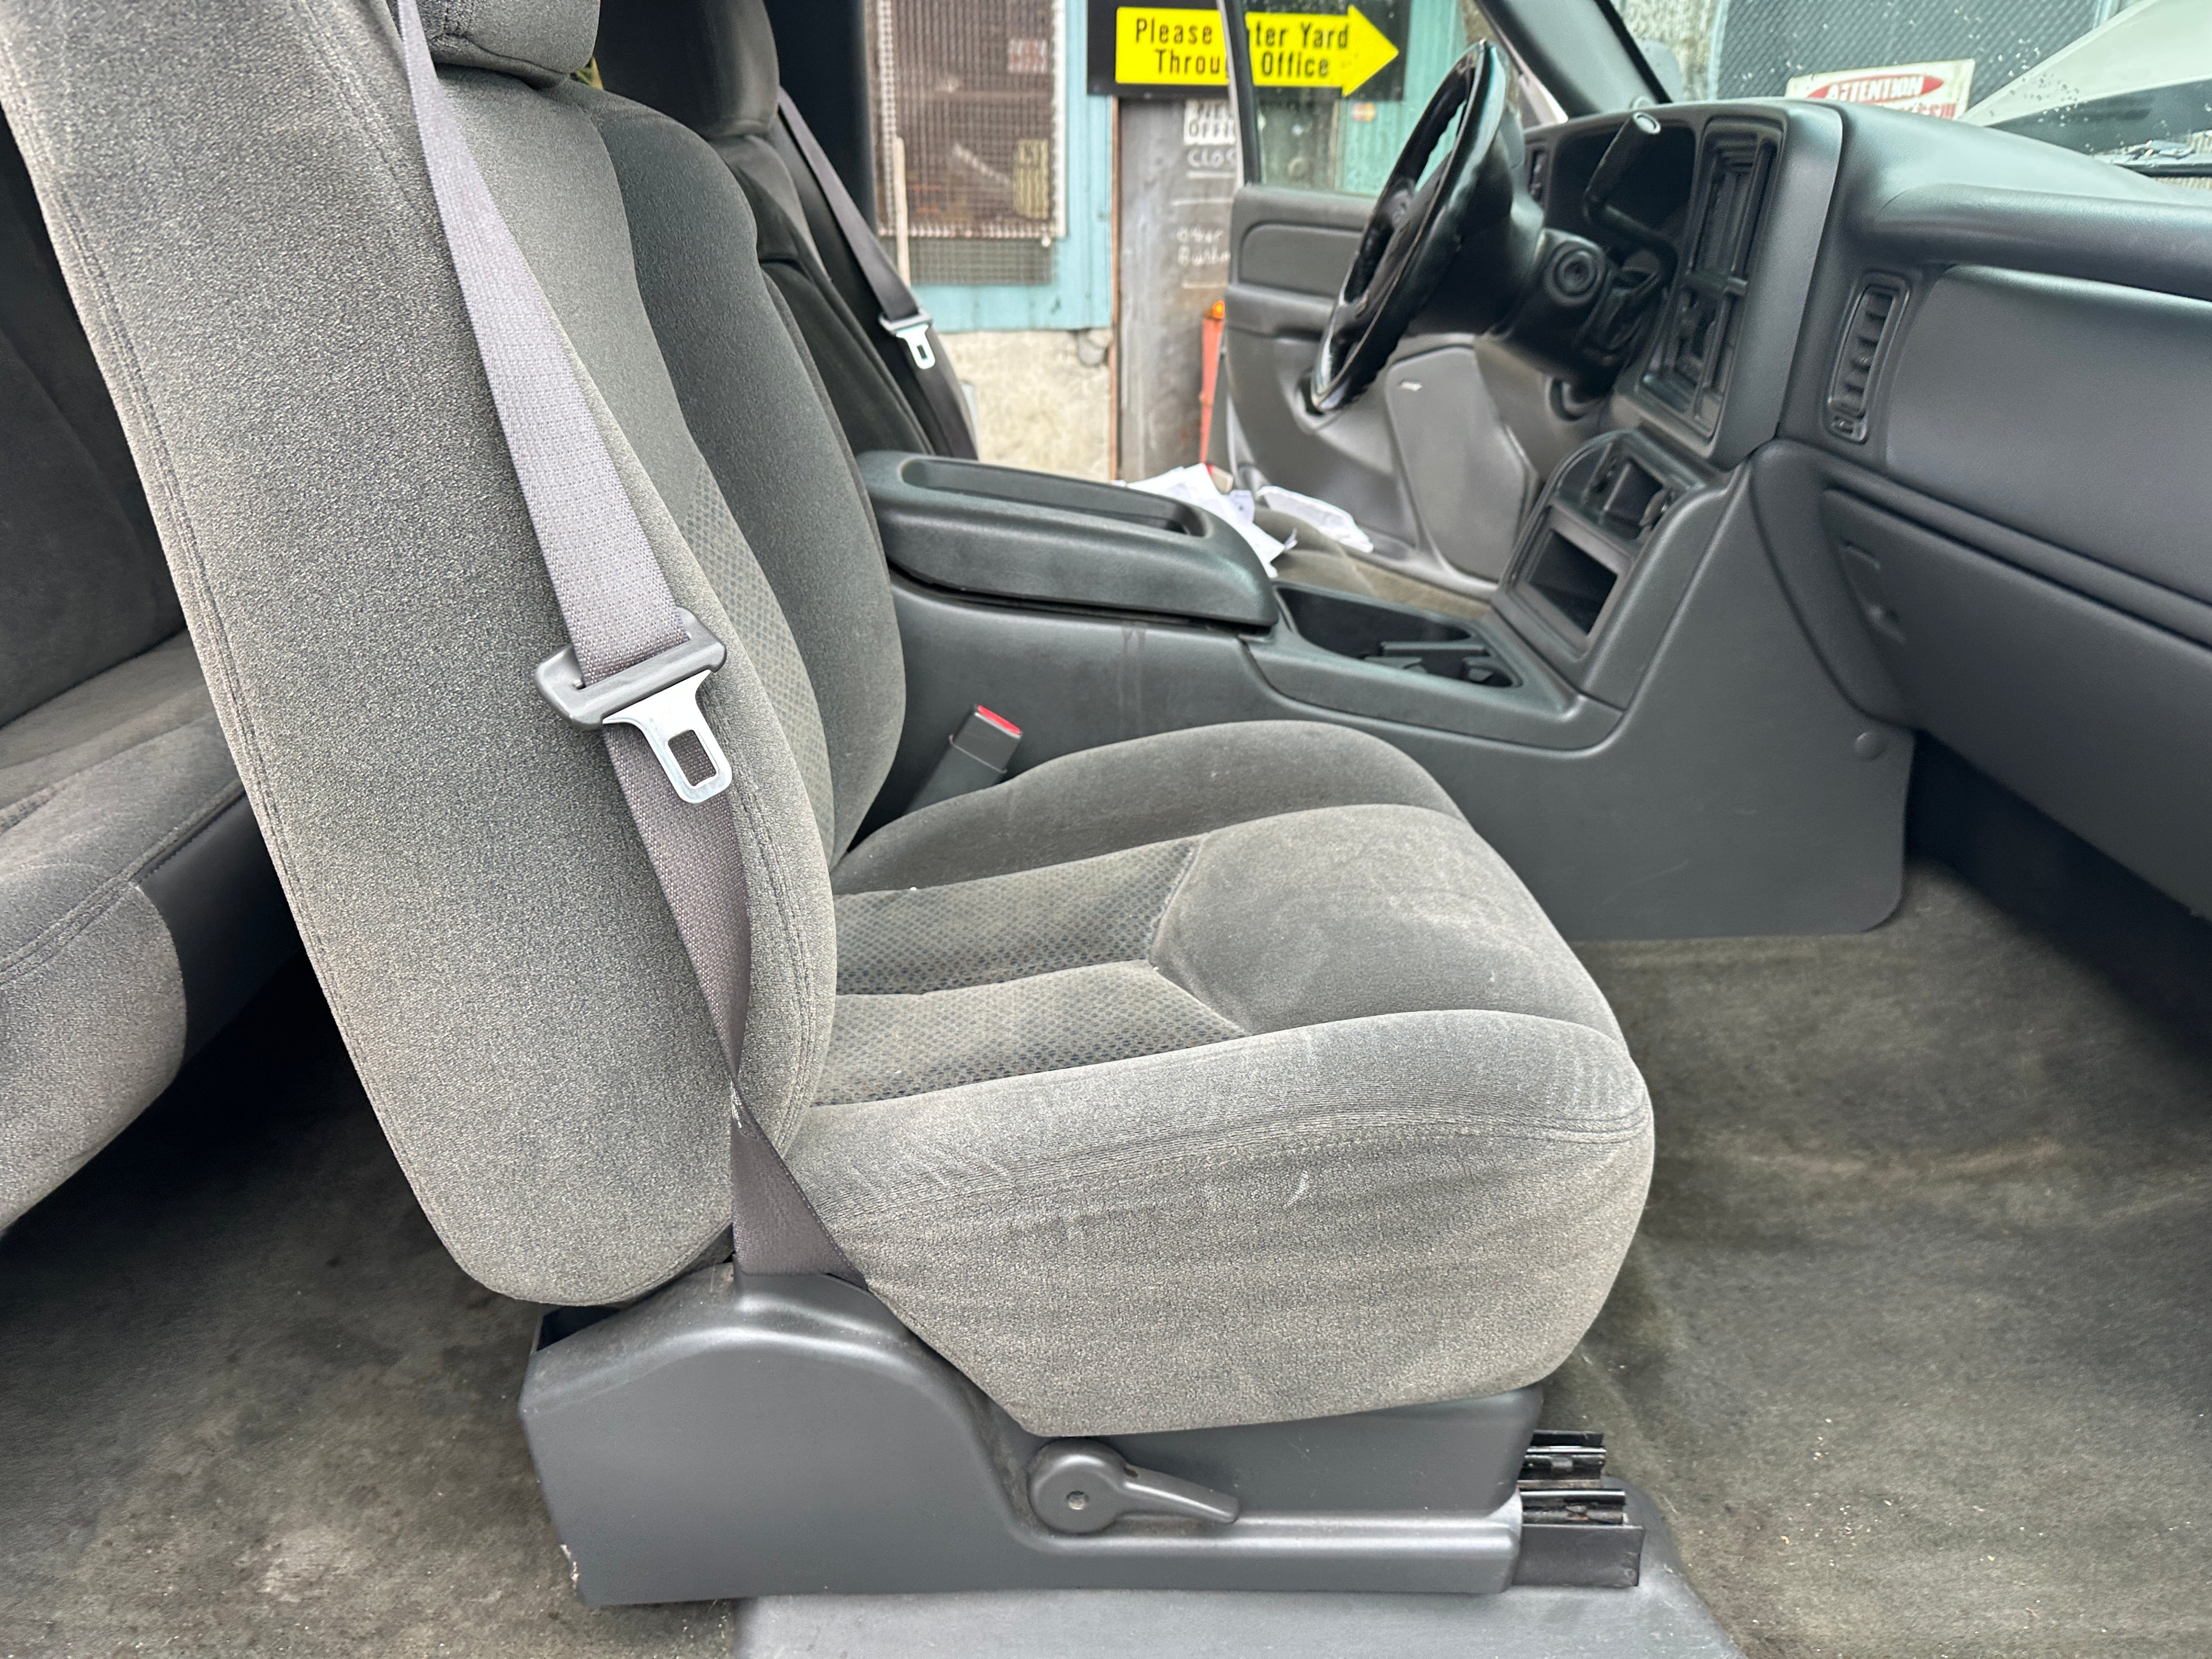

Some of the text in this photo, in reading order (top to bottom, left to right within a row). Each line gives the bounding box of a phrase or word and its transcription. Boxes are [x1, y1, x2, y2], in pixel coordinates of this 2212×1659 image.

[1136, 17, 1349, 48] Please ter Yard
[1154, 48, 1330, 79] Throu Office
